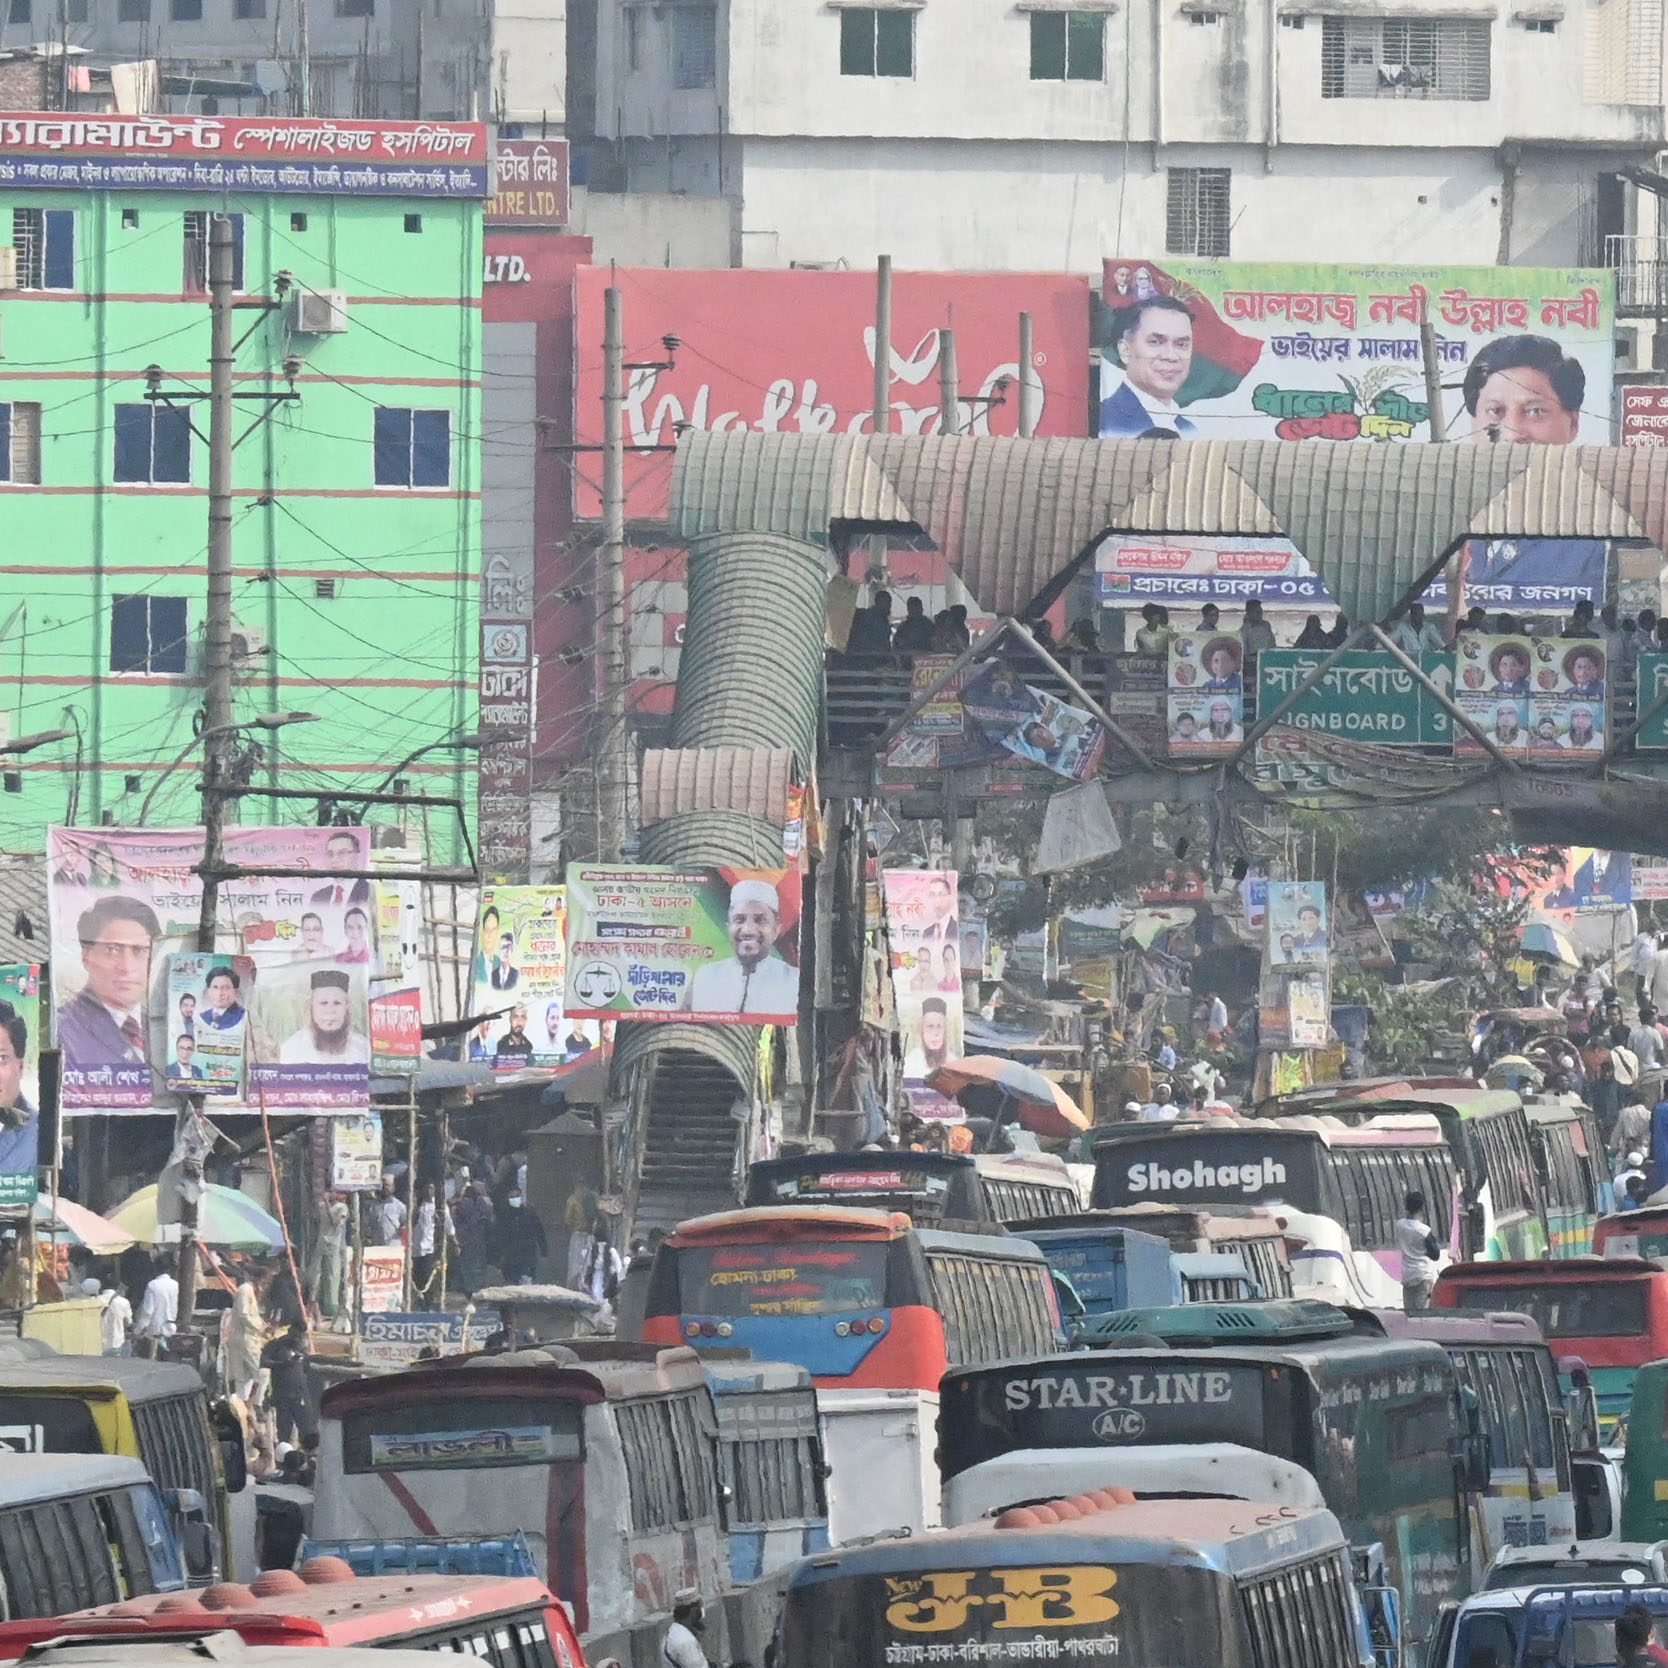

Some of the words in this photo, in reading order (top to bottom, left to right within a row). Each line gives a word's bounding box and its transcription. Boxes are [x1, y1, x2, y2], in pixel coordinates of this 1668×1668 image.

[0, 116, 225, 149] ্যারামাউন্ট
[233, 122, 376, 155] স্পেশালাইজড
[381, 126, 475, 157] হসপিটাল
[533, 144, 558, 182] লিঃ
[528, 191, 560, 216] LTD.
[1223, 290, 1358, 331] আলহাজ্ব
[1369, 283, 1429, 327] নবী
[1440, 291, 1528, 334] উল্লাহ
[1541, 288, 1601, 329] নবী
[1270, 332, 1350, 360] ভাইয়ের
[1357, 336, 1419, 362] সালাম
[1432, 712, 1449, 731] 3
[1126, 1157, 1287, 1193] Shohagh
[1004, 1377, 1118, 1411] STAR
[1128, 1371, 1233, 1406] LINE
[1100, 1416, 1142, 1437] A/C
[886, 1566, 1121, 1633] JB
